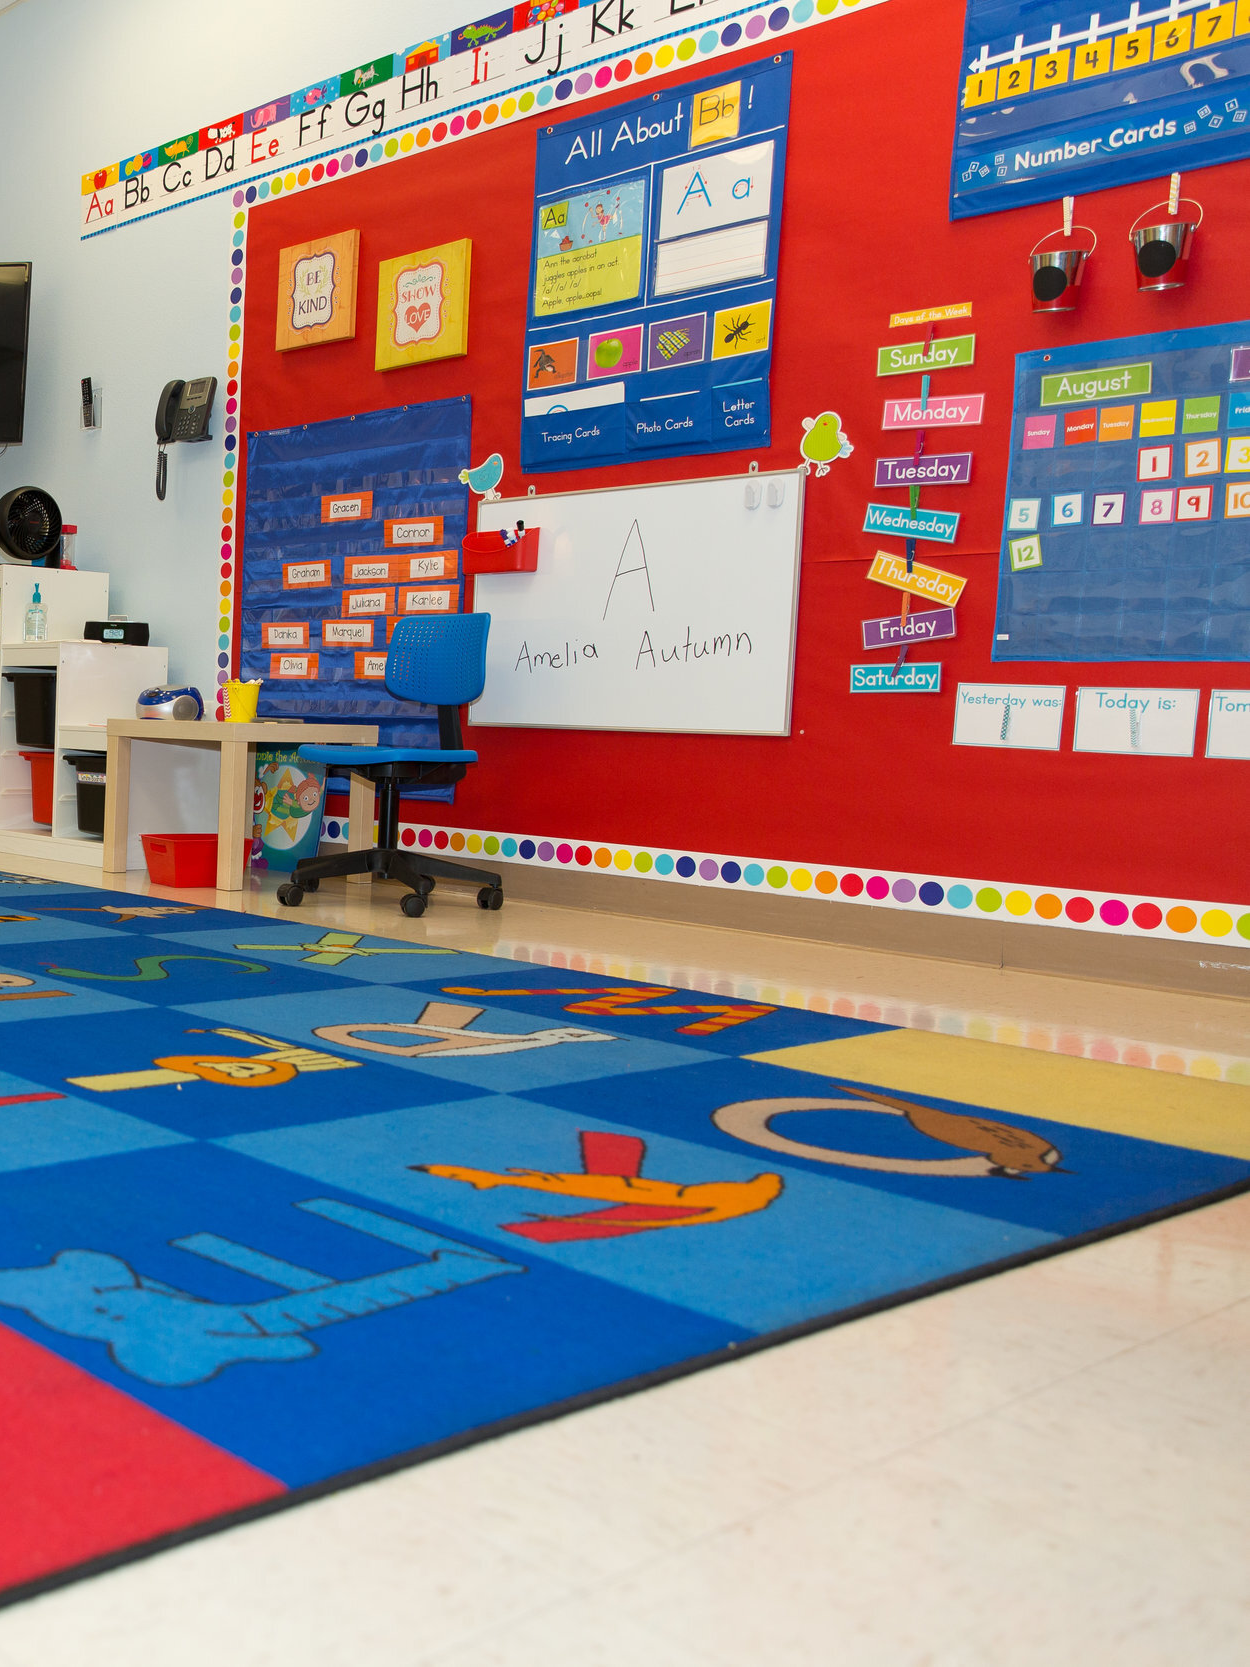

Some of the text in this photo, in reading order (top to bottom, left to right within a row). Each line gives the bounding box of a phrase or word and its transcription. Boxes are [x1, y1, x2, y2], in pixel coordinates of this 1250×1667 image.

[978, 15, 1222, 98] 1 2 3 4 5 6 7
[86, 191, 114, 224] Aa
[124, 174, 150, 209] Bb
[162, 162, 192, 193] Cc
[205, 139, 236, 181] Dd
[251, 128, 279, 165] Ee
[299, 104, 332, 147] Ff
[344, 90, 386, 135] Gg
[401, 66, 439, 111] Hh
[471, 47, 489, 87] Ii
[524, 22, 565, 76] Jj
[565, 128, 603, 165] All
[611, 102, 684, 152] About
[699, 93, 735, 127] Bb
[1014, 137, 1102, 172] Number
[1108, 118, 1177, 149] Cards
[544, 208, 565, 229] Aa
[306, 270, 323, 286] BE
[400, 284, 437, 304] SHOW
[298, 295, 328, 316] KIND
[894, 306, 968, 325] Days of the Week
[405, 308, 432, 325] LOVE
[890, 344, 959, 368] Sunday
[1057, 370, 1132, 399] August
[722, 400, 756, 413] Letter
[893, 401, 970, 423] Monday
[636, 416, 693, 435] Photo Cards
[724, 414, 755, 428] Cards
[1027, 428, 1051, 438] Sunday
[1066, 422, 1095, 433] Monday
[1102, 419, 1130, 429] Tuesday
[1186, 411, 1217, 421] Thursday
[1234, 406, 1250, 415] Frid
[542, 426, 601, 445] Tracing Cards
[884, 458, 961, 481] Tuesday
[1152, 456, 1158, 473] 1
[1196, 450, 1210, 468] 2
[332, 502, 359, 515] Gracen
[1018, 507, 1029, 523] 5
[1062, 502, 1074, 519] 6
[1102, 502, 1116, 519] 7
[1150, 499, 1163, 516] 8
[1187, 495, 1201, 513] 9
[396, 526, 431, 540] Connor
[868, 509, 955, 538] Wednesday
[1017, 545, 1035, 563] 12
[292, 566, 321, 578] Graham
[354, 566, 386, 578] Jackson
[418, 560, 439, 574] Kylie
[602, 518, 655, 621] A
[878, 556, 959, 602] Thursday
[352, 597, 381, 610] Juliana
[412, 594, 443, 606] Karlee
[332, 626, 365, 640] Marquel
[879, 617, 937, 640] Friday
[514, 626, 752, 673] Amelia Autumn
[368, 660, 385, 672] Ame
[854, 668, 937, 689] Saturday
[962, 691, 1062, 709] Yesterday was:
[1096, 692, 1176, 714] Today is:
